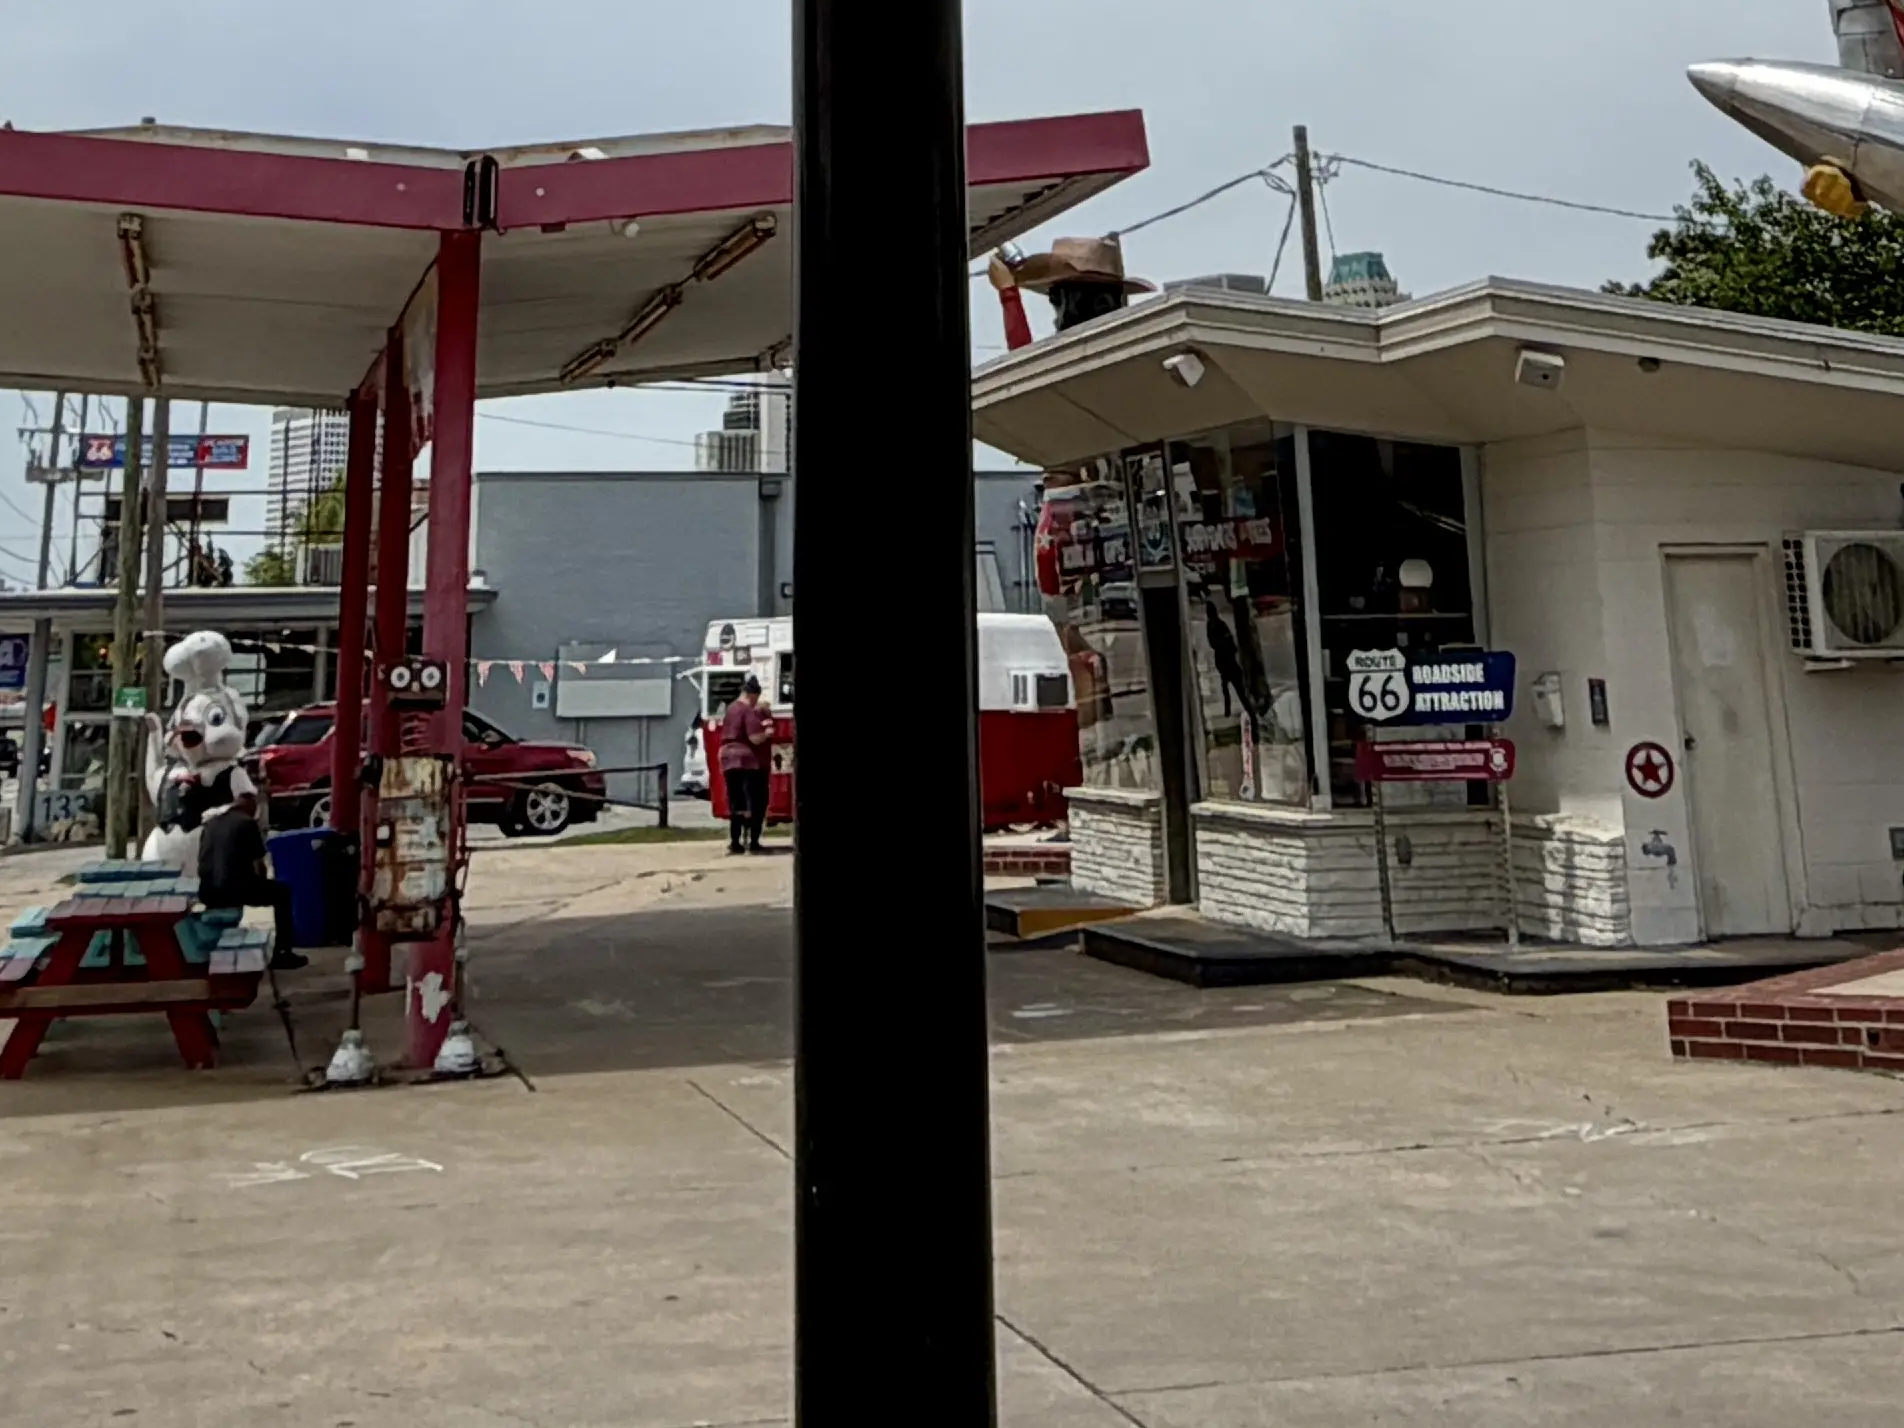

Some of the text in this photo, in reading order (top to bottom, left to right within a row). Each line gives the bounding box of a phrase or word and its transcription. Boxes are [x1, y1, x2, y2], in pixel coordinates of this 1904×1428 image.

[1355, 655, 1396, 668] ROUTE
[1412, 663, 1485, 684] ROADSIDE
[1358, 674, 1400, 713] 66
[1415, 690, 1505, 712] ATTRACTION
